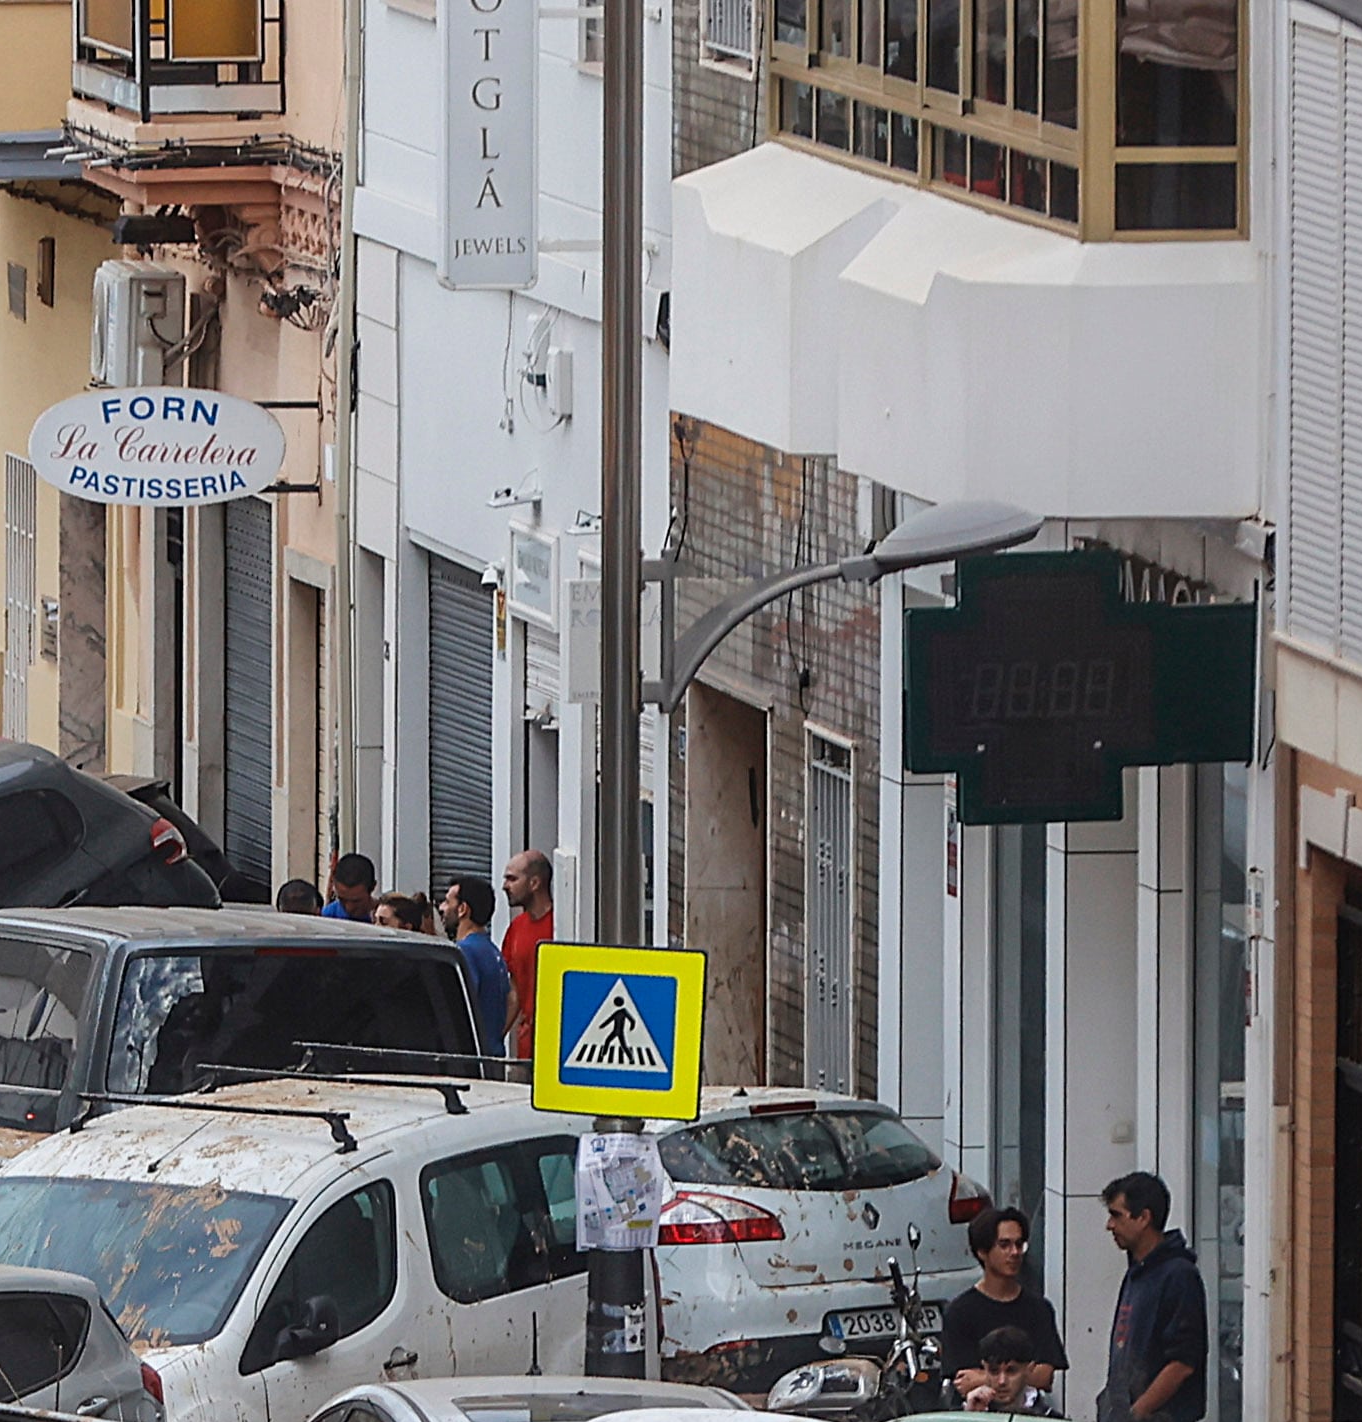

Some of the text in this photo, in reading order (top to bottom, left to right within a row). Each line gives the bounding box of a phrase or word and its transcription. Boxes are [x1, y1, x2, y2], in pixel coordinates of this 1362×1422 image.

[454, 236, 527, 259] JEWELS
[101, 395, 219, 426] FORN
[50, 423, 258, 467] La Carretera
[69, 465, 247, 499] PASTISSERIA
[843, 1238, 902, 1250] MEGANE
[843, 1312, 897, 1336] 2038
